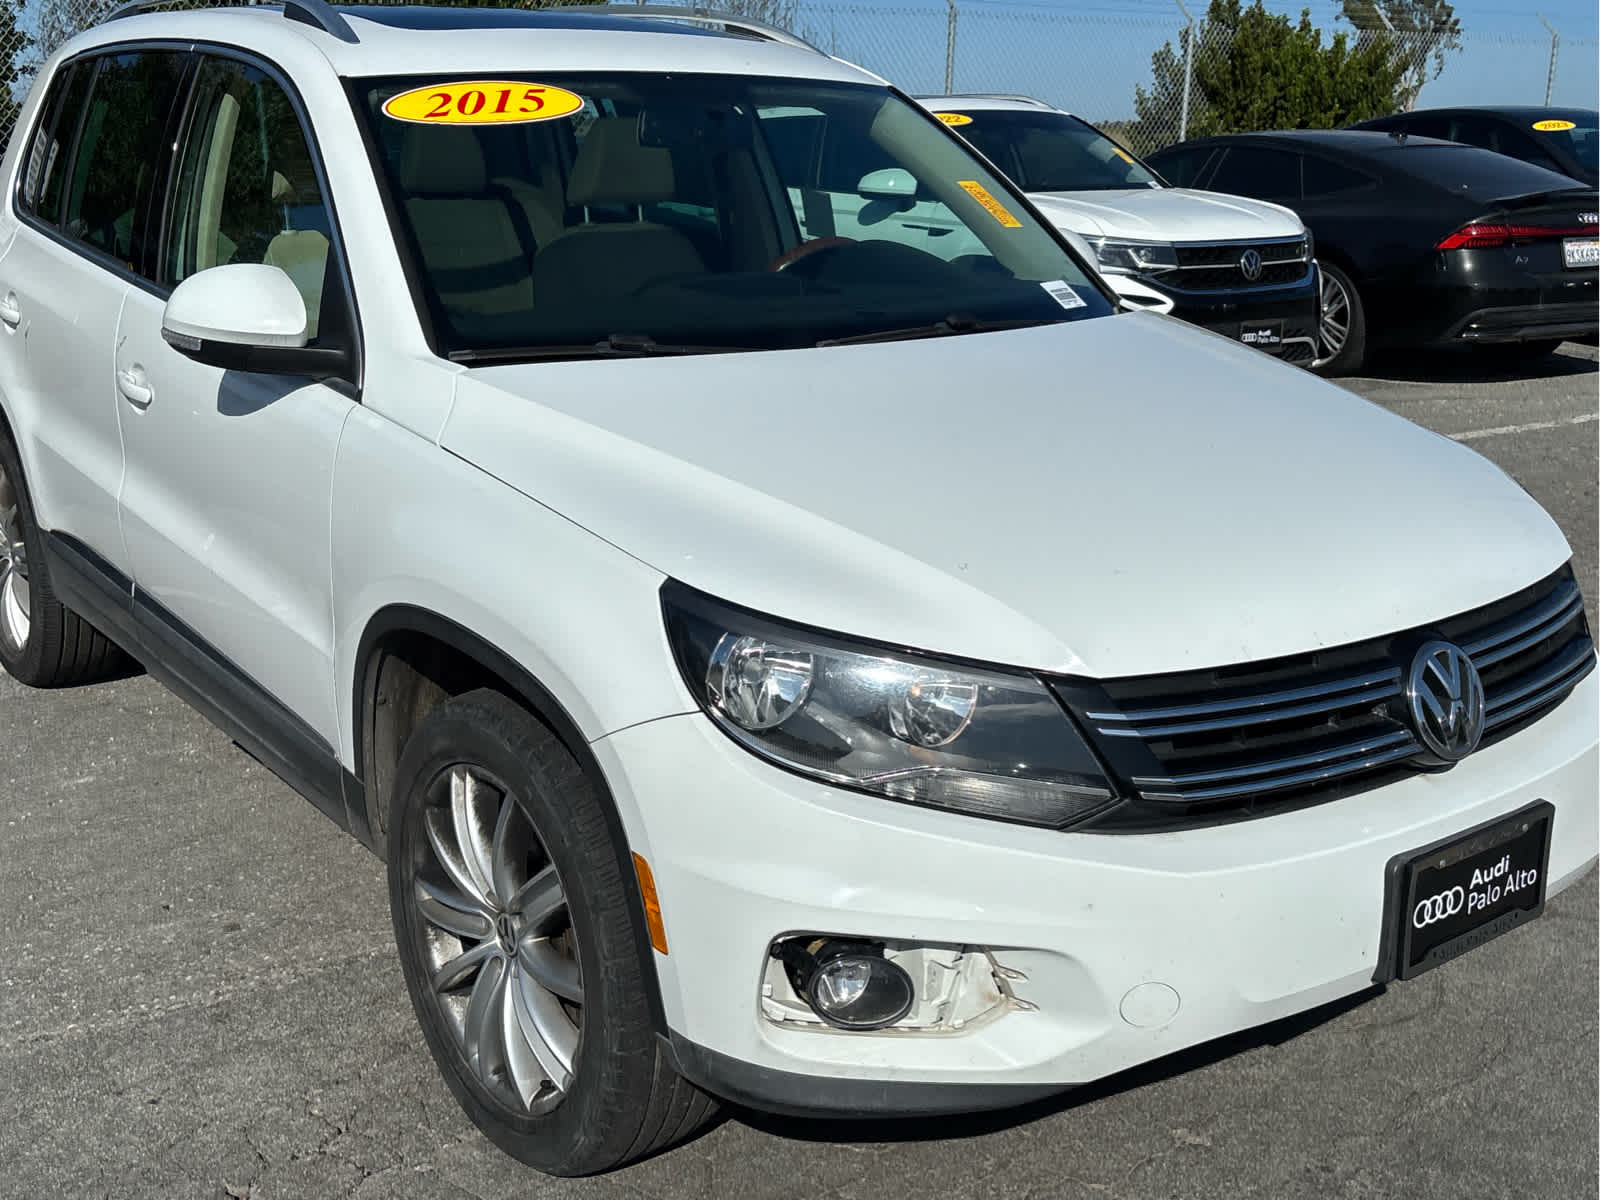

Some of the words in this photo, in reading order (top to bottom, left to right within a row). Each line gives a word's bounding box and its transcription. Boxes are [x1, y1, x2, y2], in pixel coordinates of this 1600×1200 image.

[424, 88, 546, 118] 2015
[1469, 855, 1510, 890] Audi
[1467, 885, 1501, 915] Palo
[1503, 868, 1537, 897] Alto
